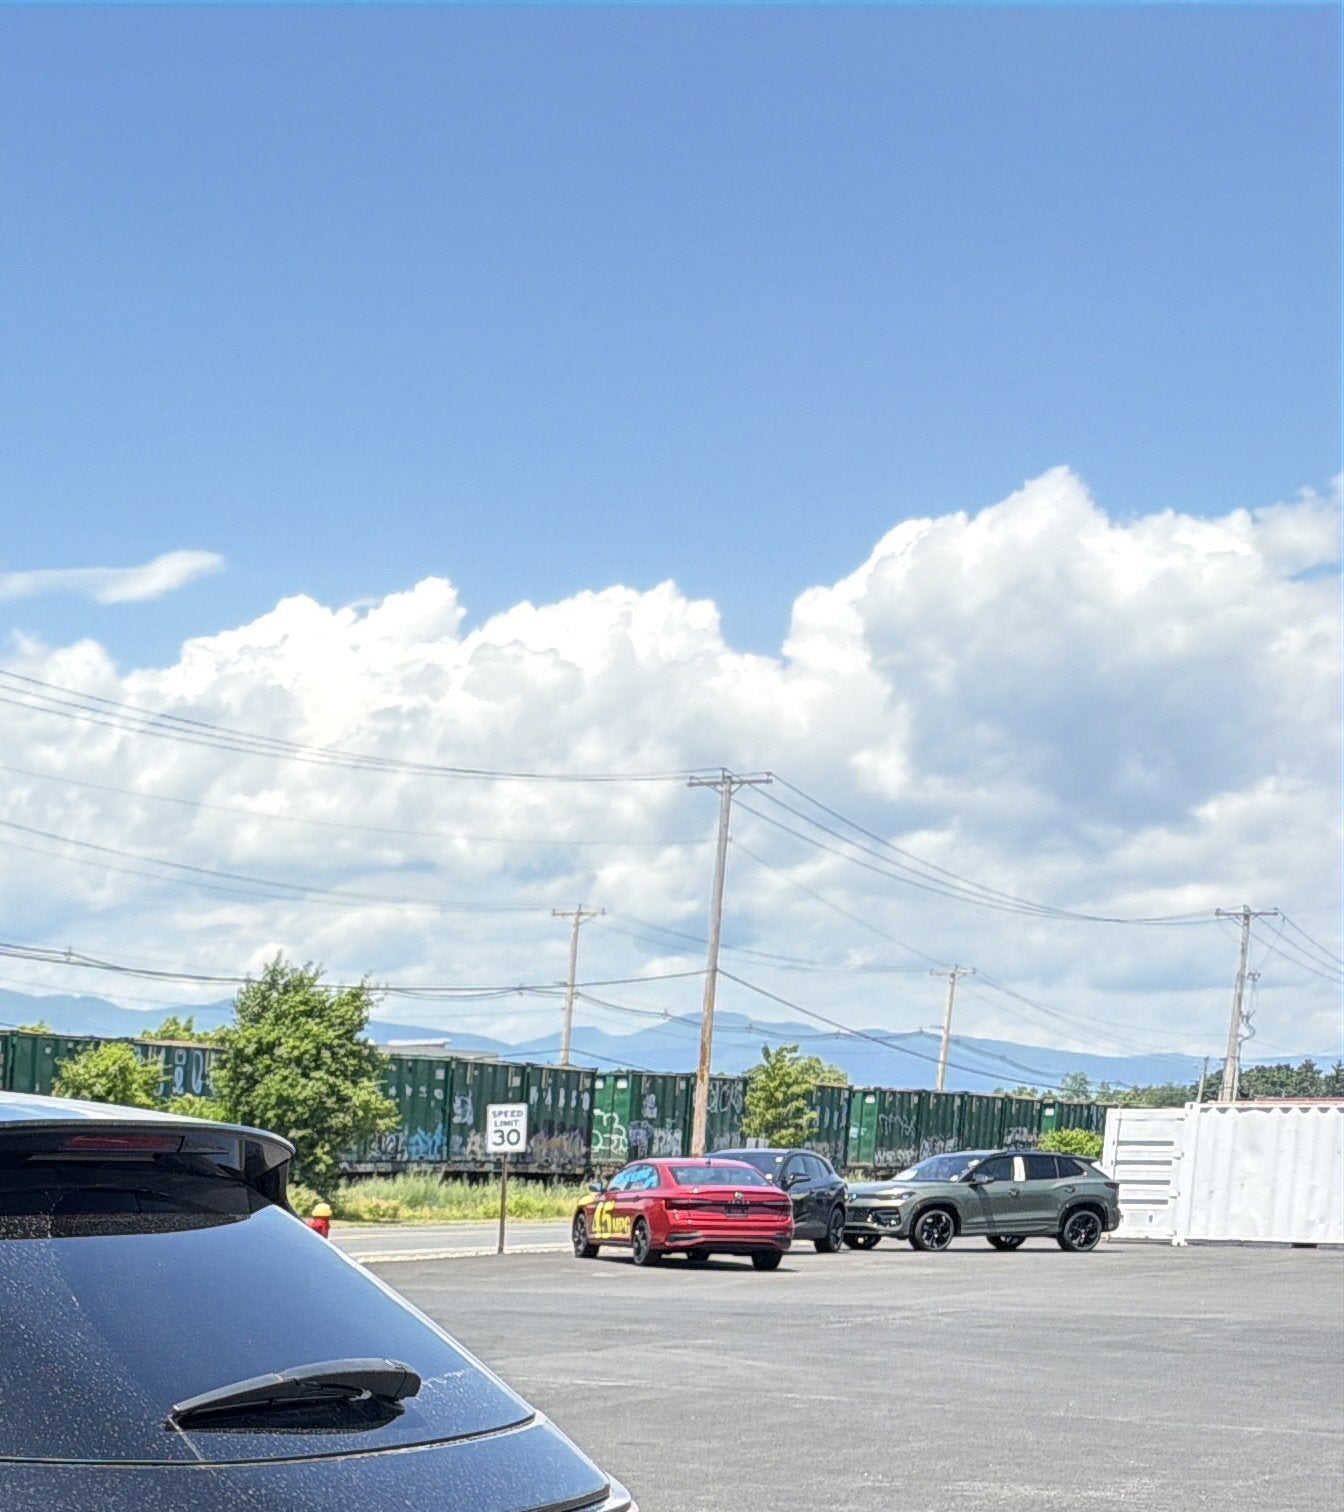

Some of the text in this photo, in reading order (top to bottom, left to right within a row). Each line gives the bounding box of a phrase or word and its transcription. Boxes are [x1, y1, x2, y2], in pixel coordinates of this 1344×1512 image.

[491, 1110, 524, 1119] SPEED
[494, 1119, 519, 1127] LIMIT
[492, 1128, 521, 1146] 30
